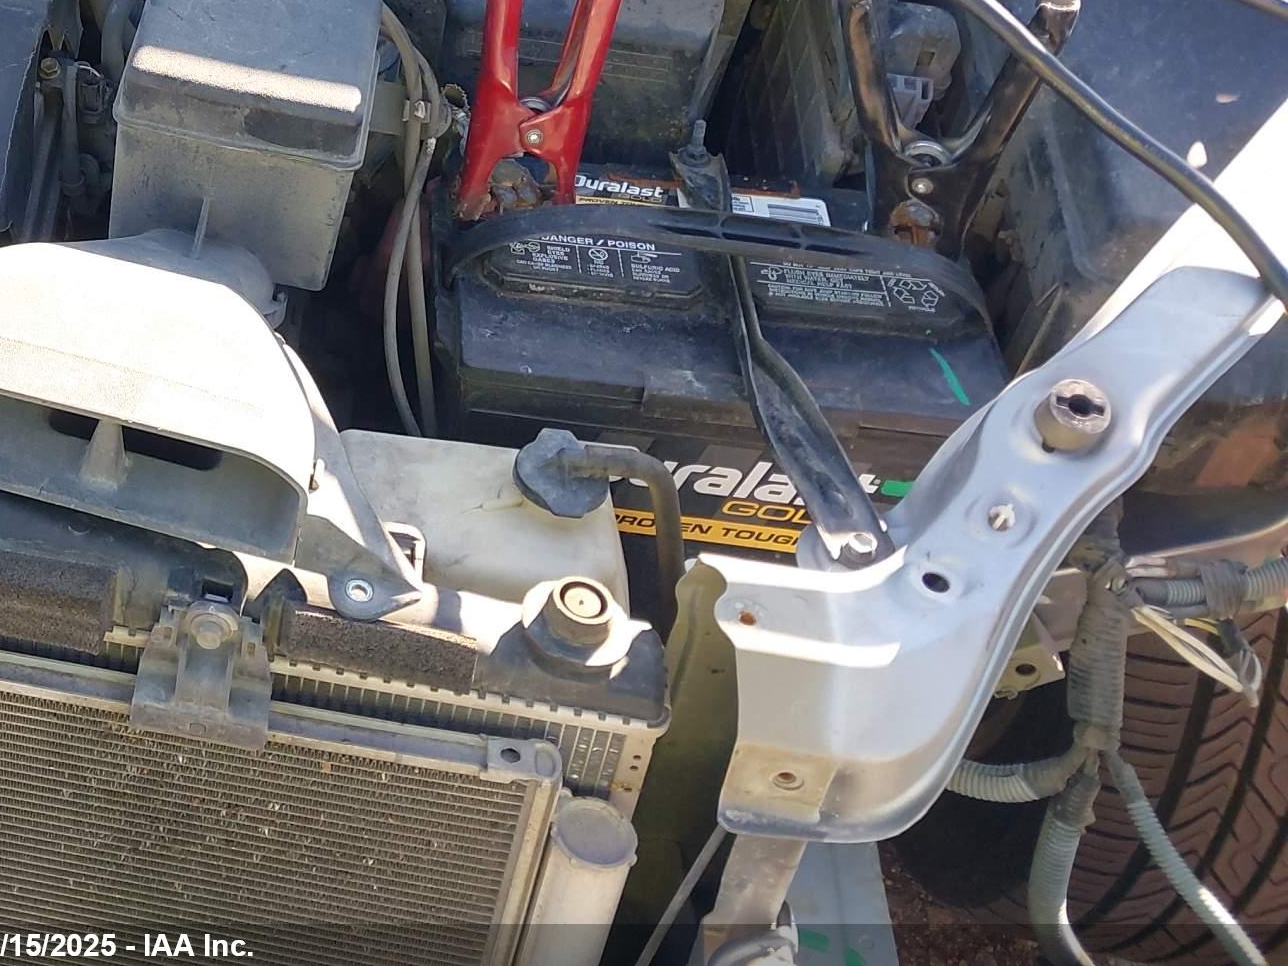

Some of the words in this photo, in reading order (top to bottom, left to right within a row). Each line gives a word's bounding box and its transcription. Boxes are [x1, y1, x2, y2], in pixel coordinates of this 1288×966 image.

[575, 174, 664, 198] Duralast
[607, 240, 656, 252] POISON
[721, 497, 812, 525] GOL
